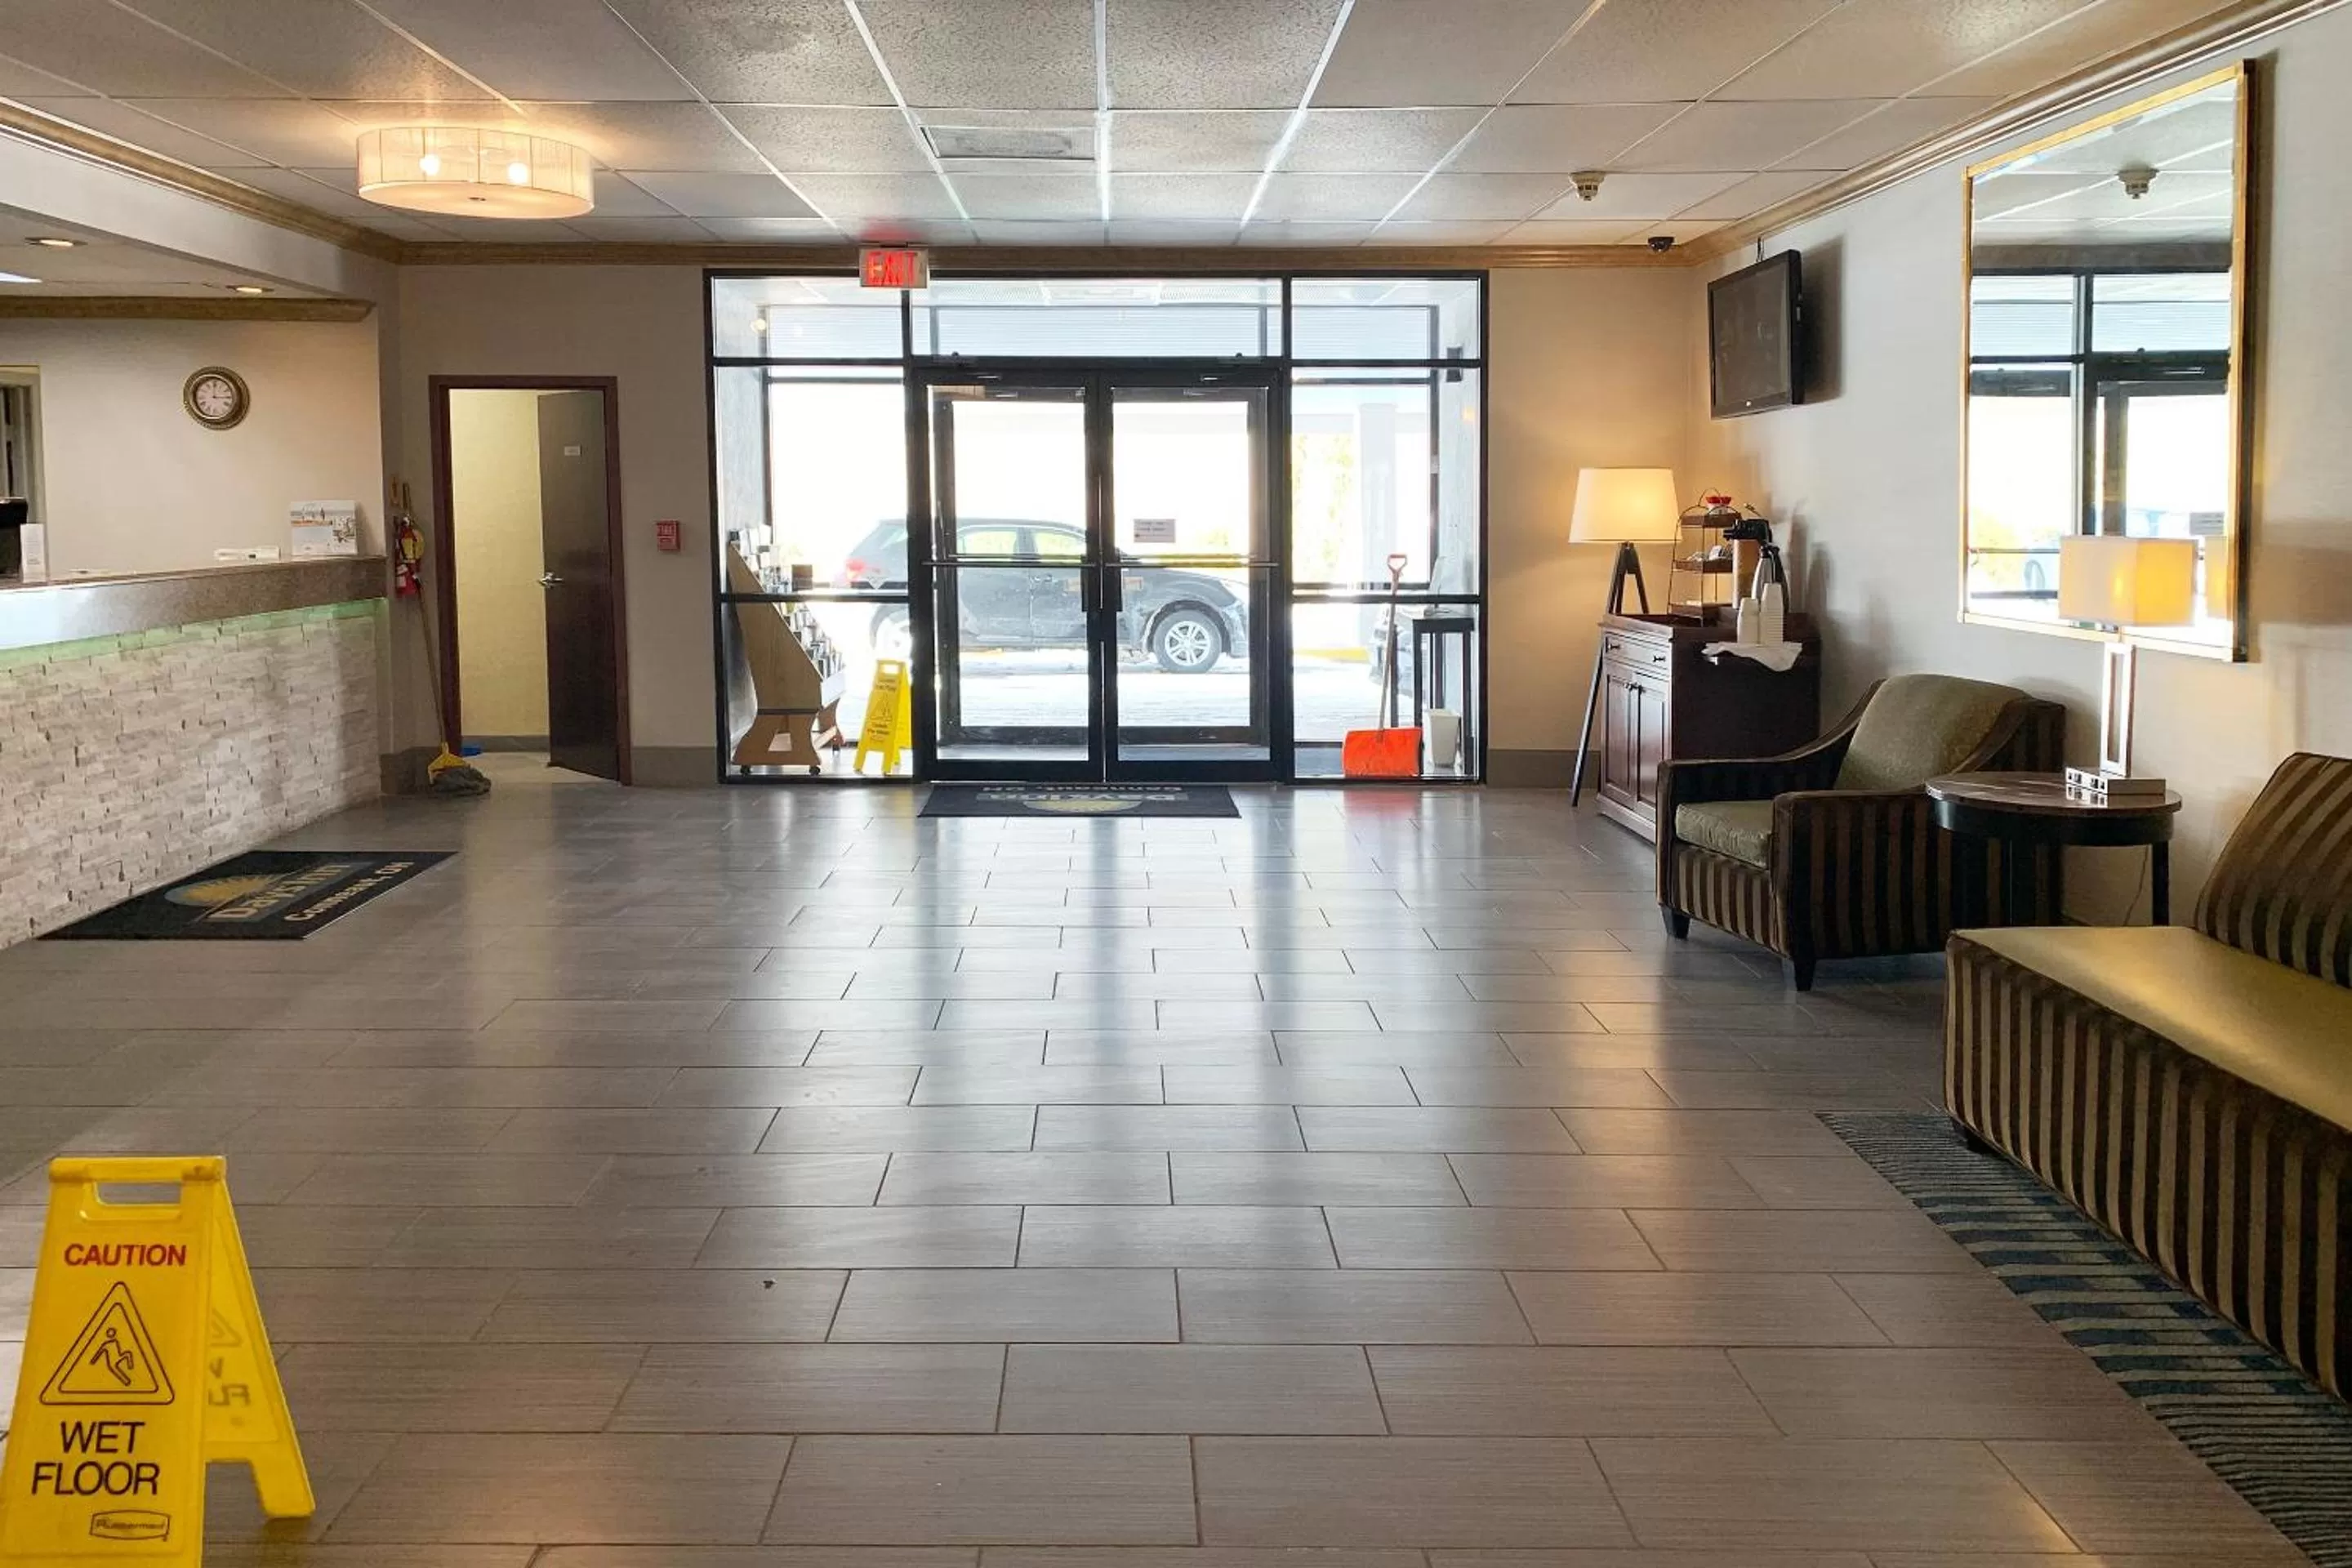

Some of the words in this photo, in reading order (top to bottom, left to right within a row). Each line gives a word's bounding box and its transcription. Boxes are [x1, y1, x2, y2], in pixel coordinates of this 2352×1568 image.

[64, 1243, 187, 1267] CAUTION
[60, 1420, 145, 1454] WET
[31, 1460, 160, 1496] FLOOR
